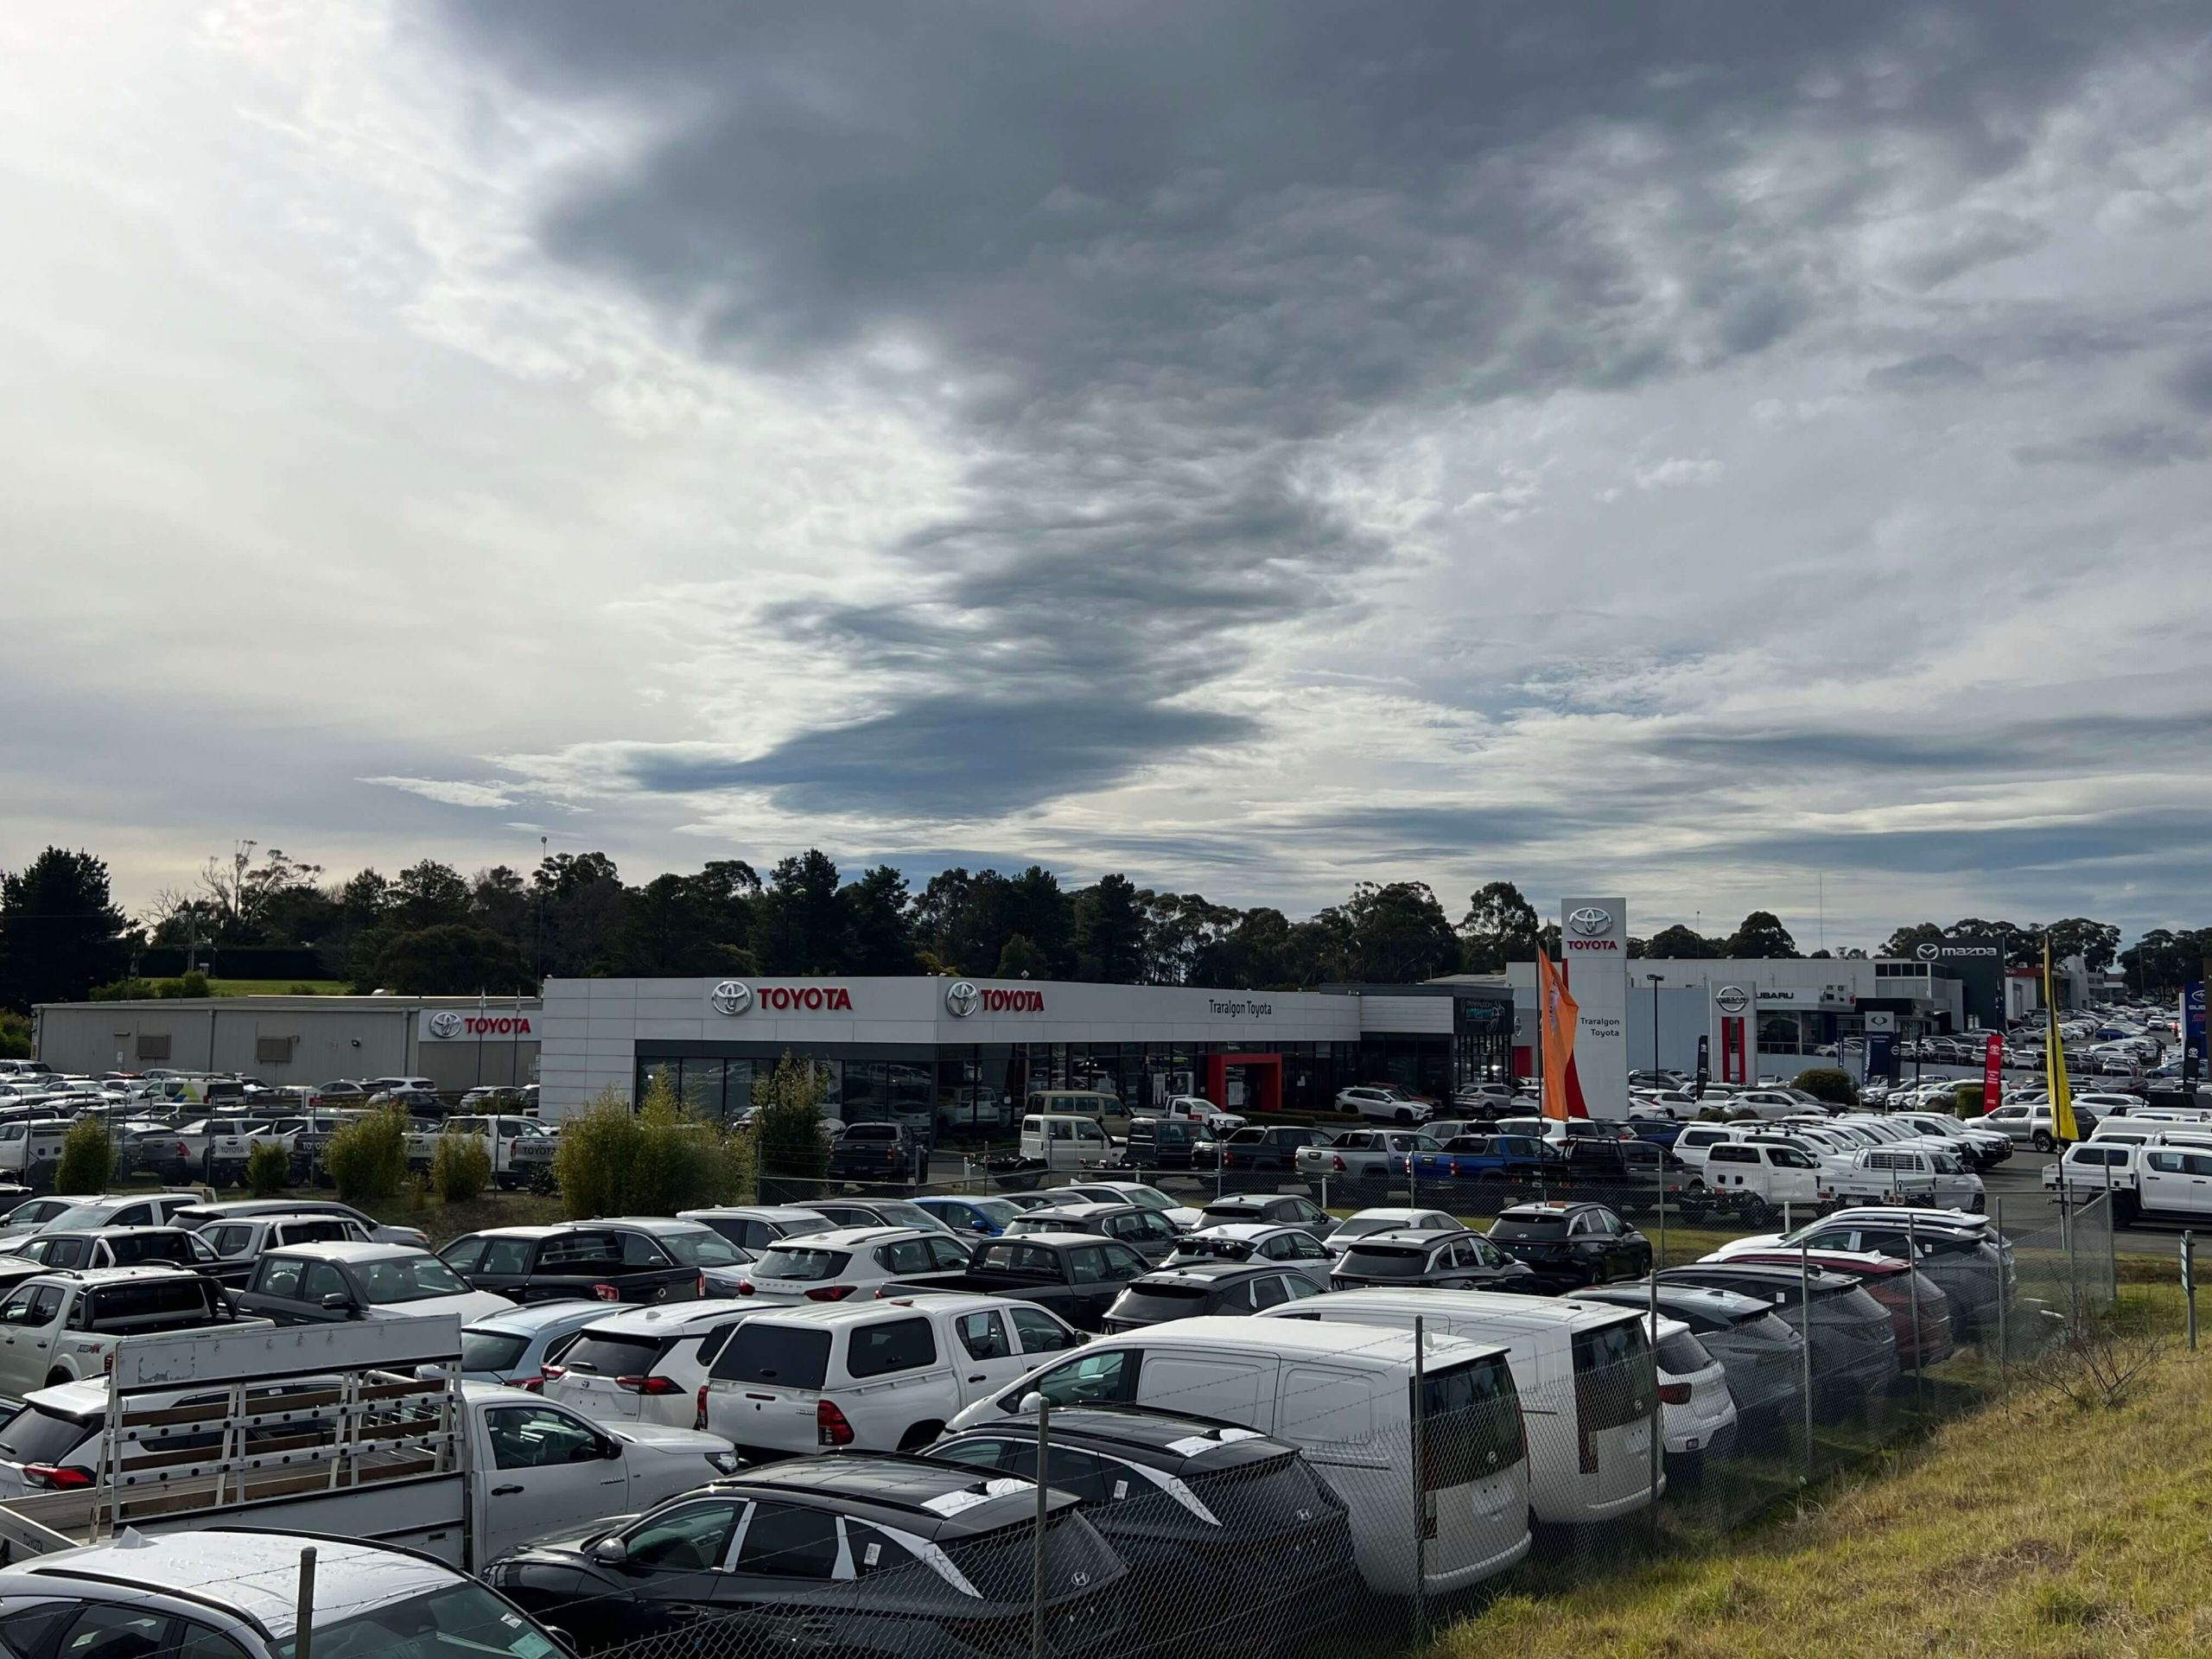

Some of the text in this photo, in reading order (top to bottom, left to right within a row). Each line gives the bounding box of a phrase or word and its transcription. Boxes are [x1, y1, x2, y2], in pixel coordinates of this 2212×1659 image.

[1567, 940, 1618, 950] TOYOTA
[756, 987, 853, 1010] TOYOTA
[981, 988, 1045, 1012] TOYOTA
[1209, 999, 1272, 1018] Traralgon Toyota
[465, 1018, 531, 1034] TOYOTA
[1580, 1017, 1620, 1027] Traralgon
[1591, 1028, 1619, 1038] Toyota
